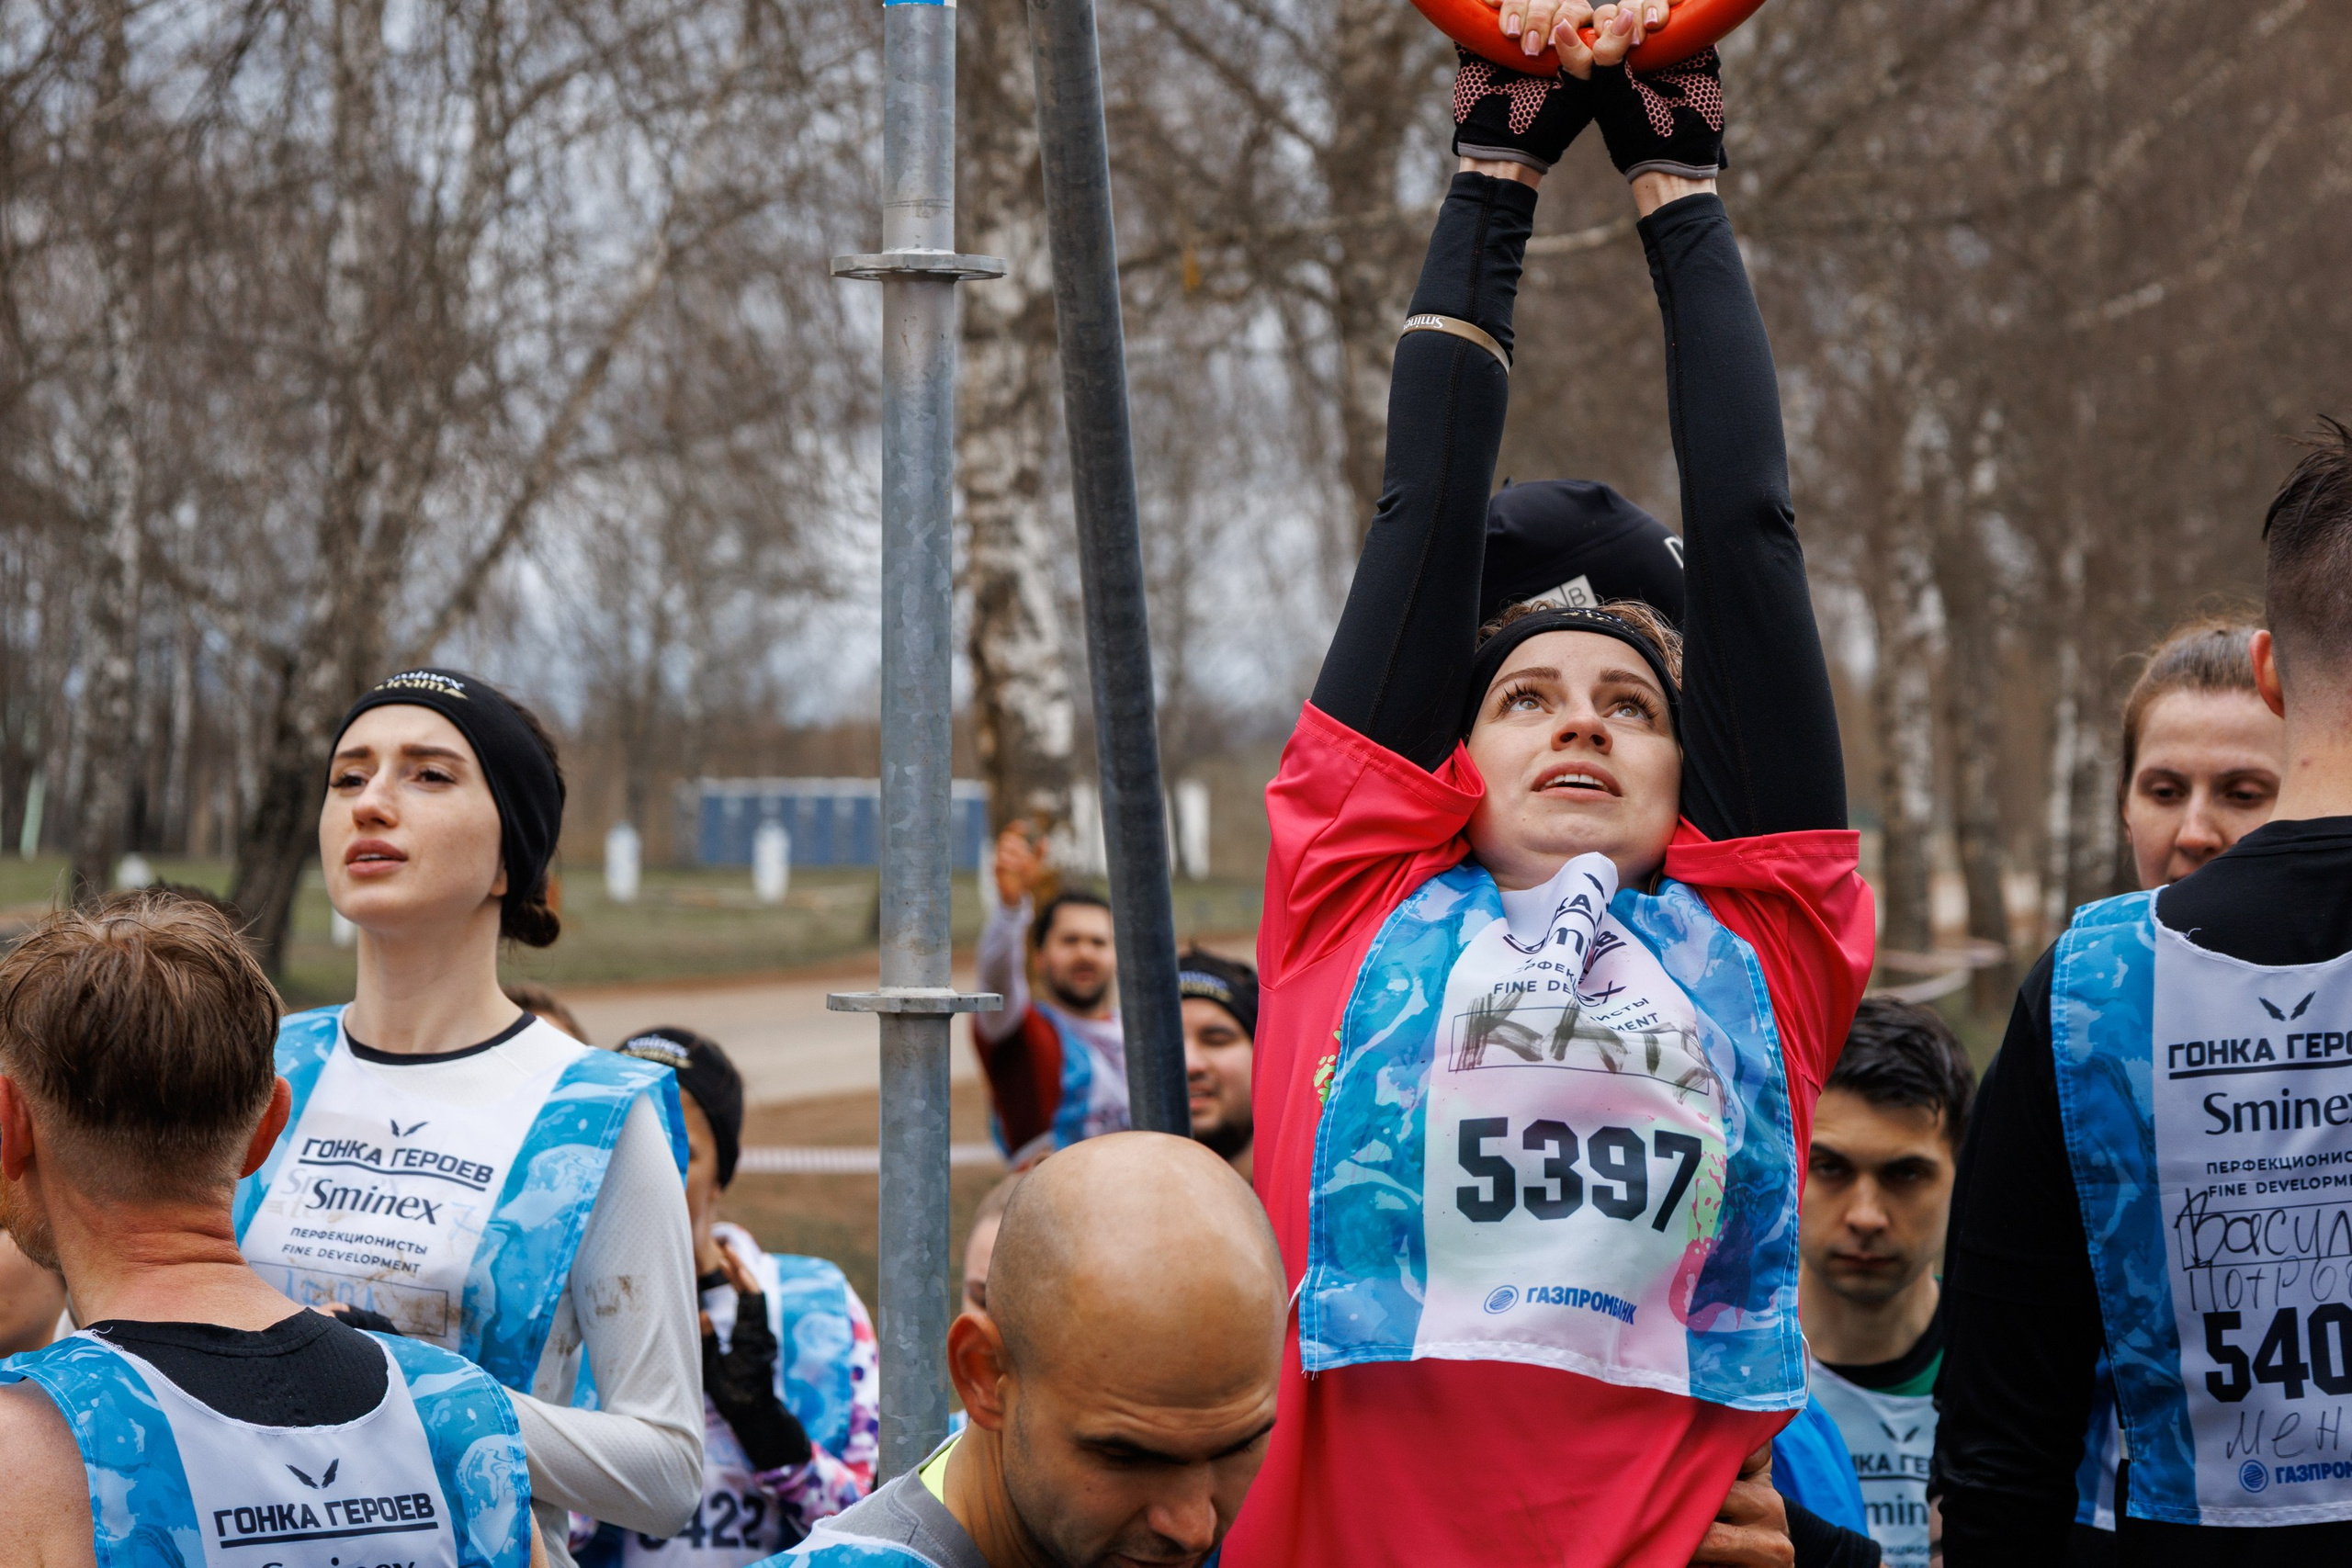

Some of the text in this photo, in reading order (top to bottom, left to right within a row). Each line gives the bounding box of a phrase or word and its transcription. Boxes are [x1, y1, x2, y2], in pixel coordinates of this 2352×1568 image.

[1494, 980, 1537, 995] FINE
[2169, 1038, 2276, 1068] ГОНКА
[2203, 1089, 2352, 1135] Smine
[301, 1138, 381, 1166] ГОНКА
[390, 1148, 494, 1184] ГЕРОЕВ
[1456, 1117, 1702, 1233] 5397
[305, 1179, 443, 1225] Sminex
[2210, 1174, 2352, 1198] FINE DEVELOPM
[281, 1244, 422, 1274] FINE DEVELOPMENT
[290, 1227, 428, 1255] ПЕРФЕКЦИОНИСТЫ
[1525, 1286, 1635, 1325] ГАЗПРОМБАНК
[2203, 1303, 2352, 1403] 540
[213, 1493, 435, 1538] ГОНКА ГЕРОЕВ
[637, 1492, 766, 1551] 422
[1865, 1494, 1928, 1525] min
